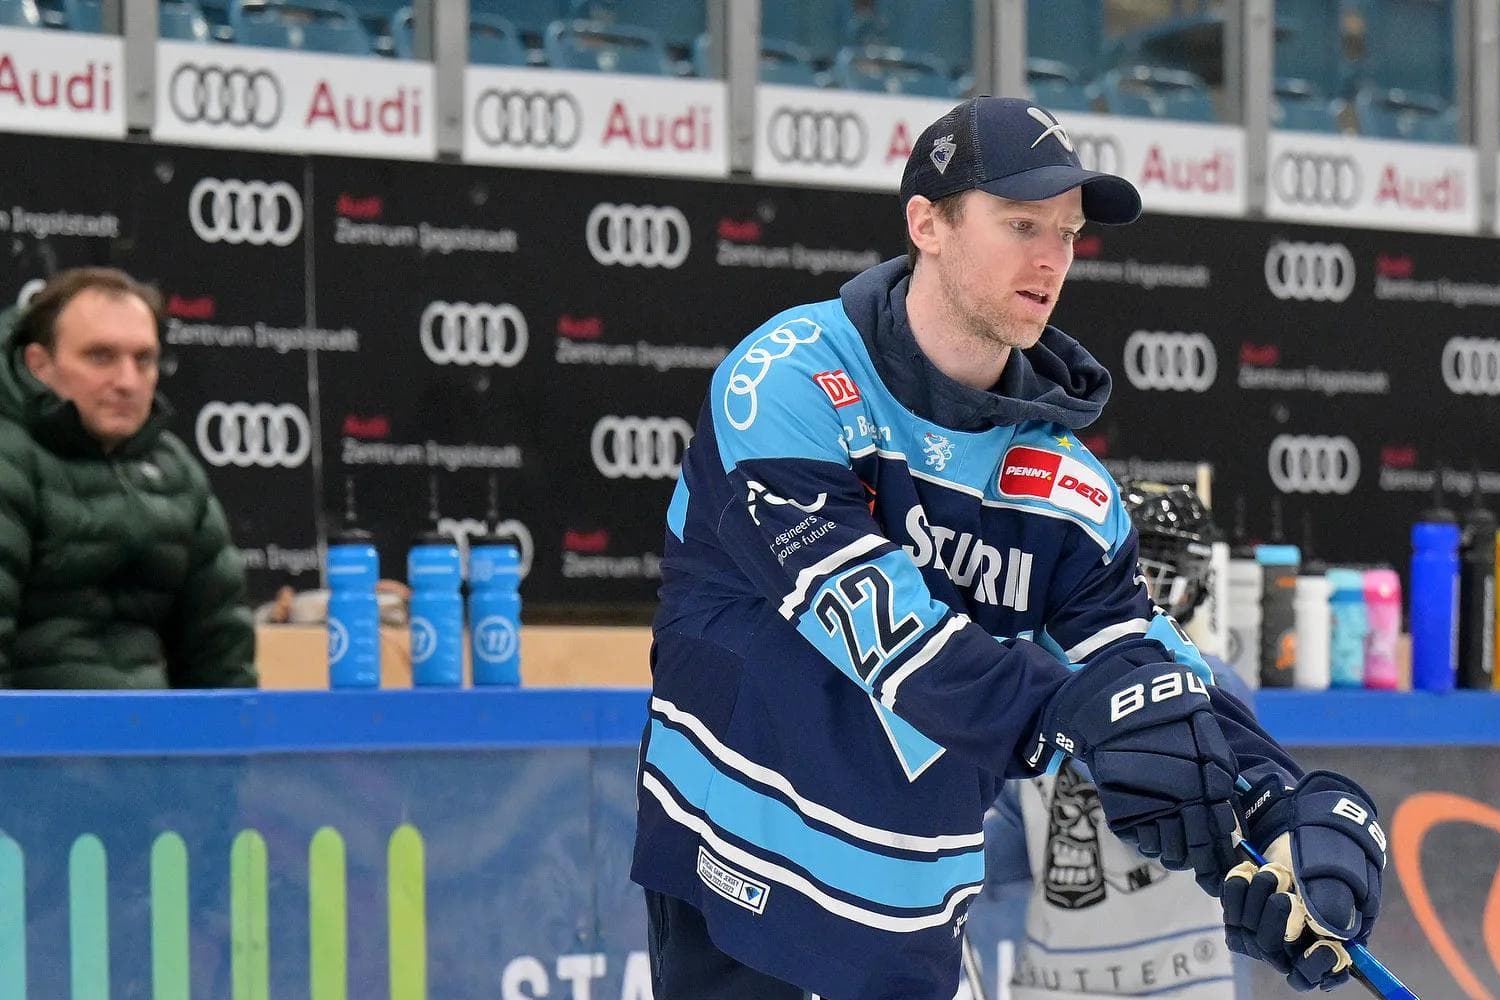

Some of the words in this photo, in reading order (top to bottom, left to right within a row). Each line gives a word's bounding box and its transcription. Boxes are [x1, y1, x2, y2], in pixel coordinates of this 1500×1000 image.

[0, 56, 112, 112] Audi
[304, 81, 423, 137] Audi
[600, 101, 712, 152] Audi
[1139, 143, 1236, 193] Audi
[1376, 164, 1465, 213] Audi
[335, 218, 418, 247] Zentrum
[166, 318, 253, 346] Zentrum
[341, 437, 424, 465] Zentrum
[802, 521, 837, 546] future
[815, 565, 924, 683] 22
[1055, 731, 1075, 754] 22
